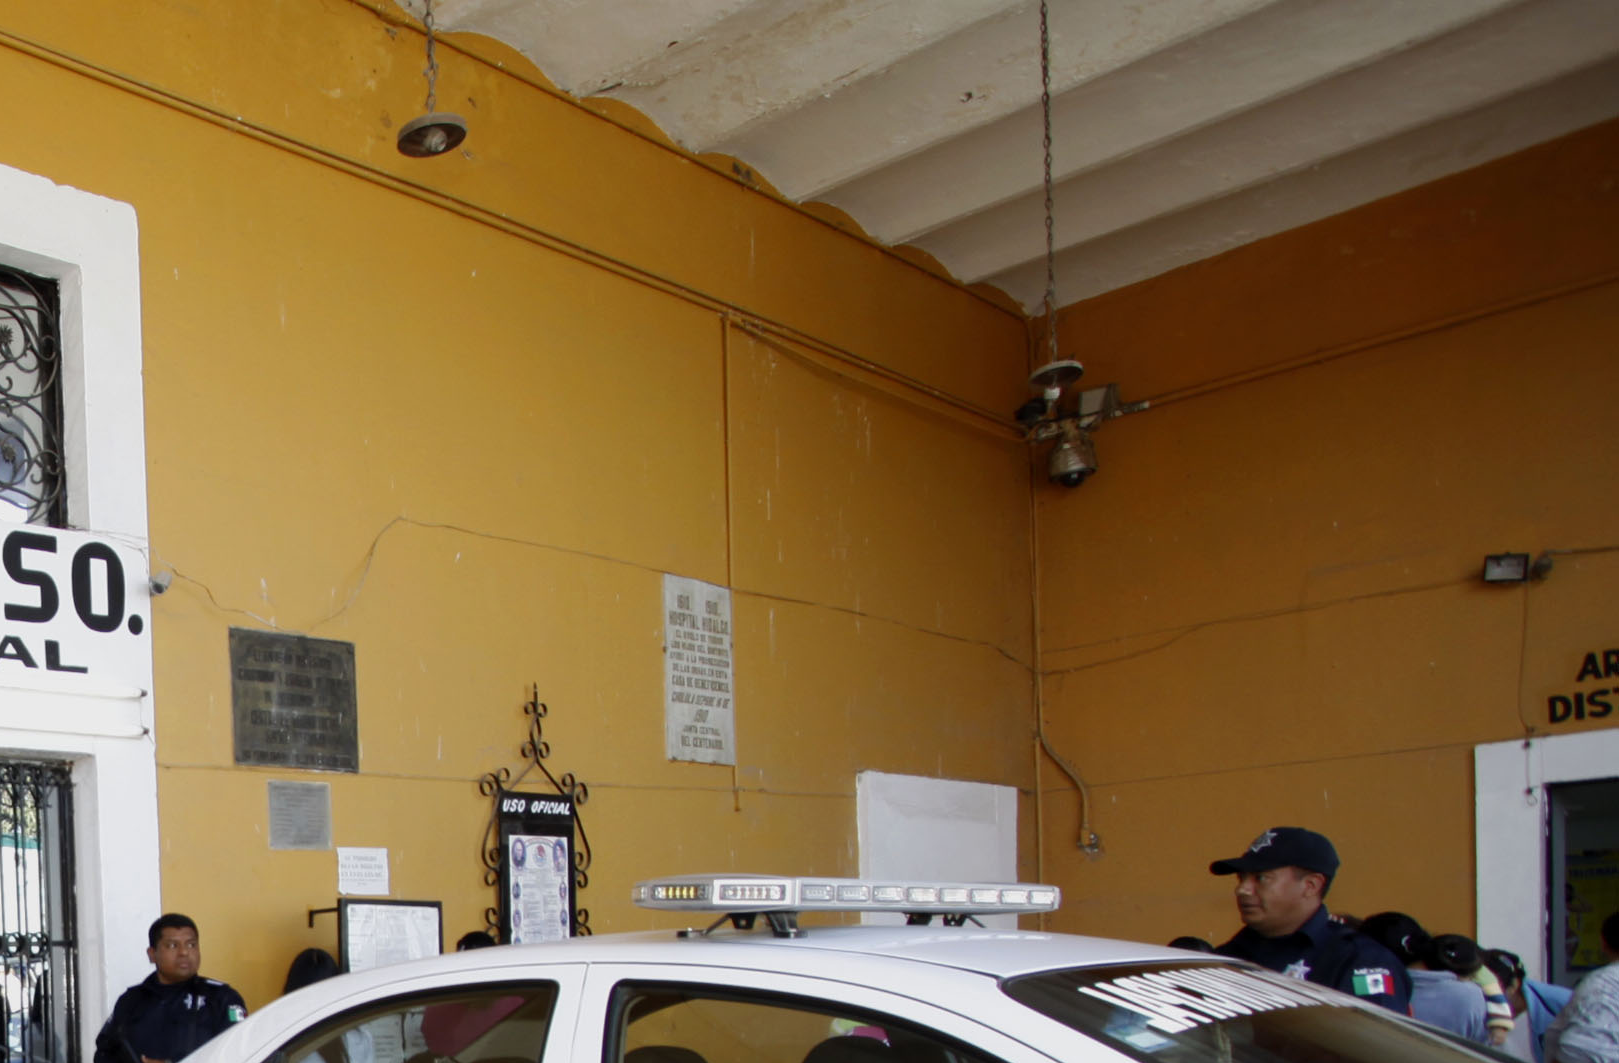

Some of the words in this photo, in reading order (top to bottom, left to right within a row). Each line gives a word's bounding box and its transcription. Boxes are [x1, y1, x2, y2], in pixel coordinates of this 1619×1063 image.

[1, 530, 144, 636] SO.
[502, 798, 526, 813] USO
[531, 800, 571, 816] OFICIAL
